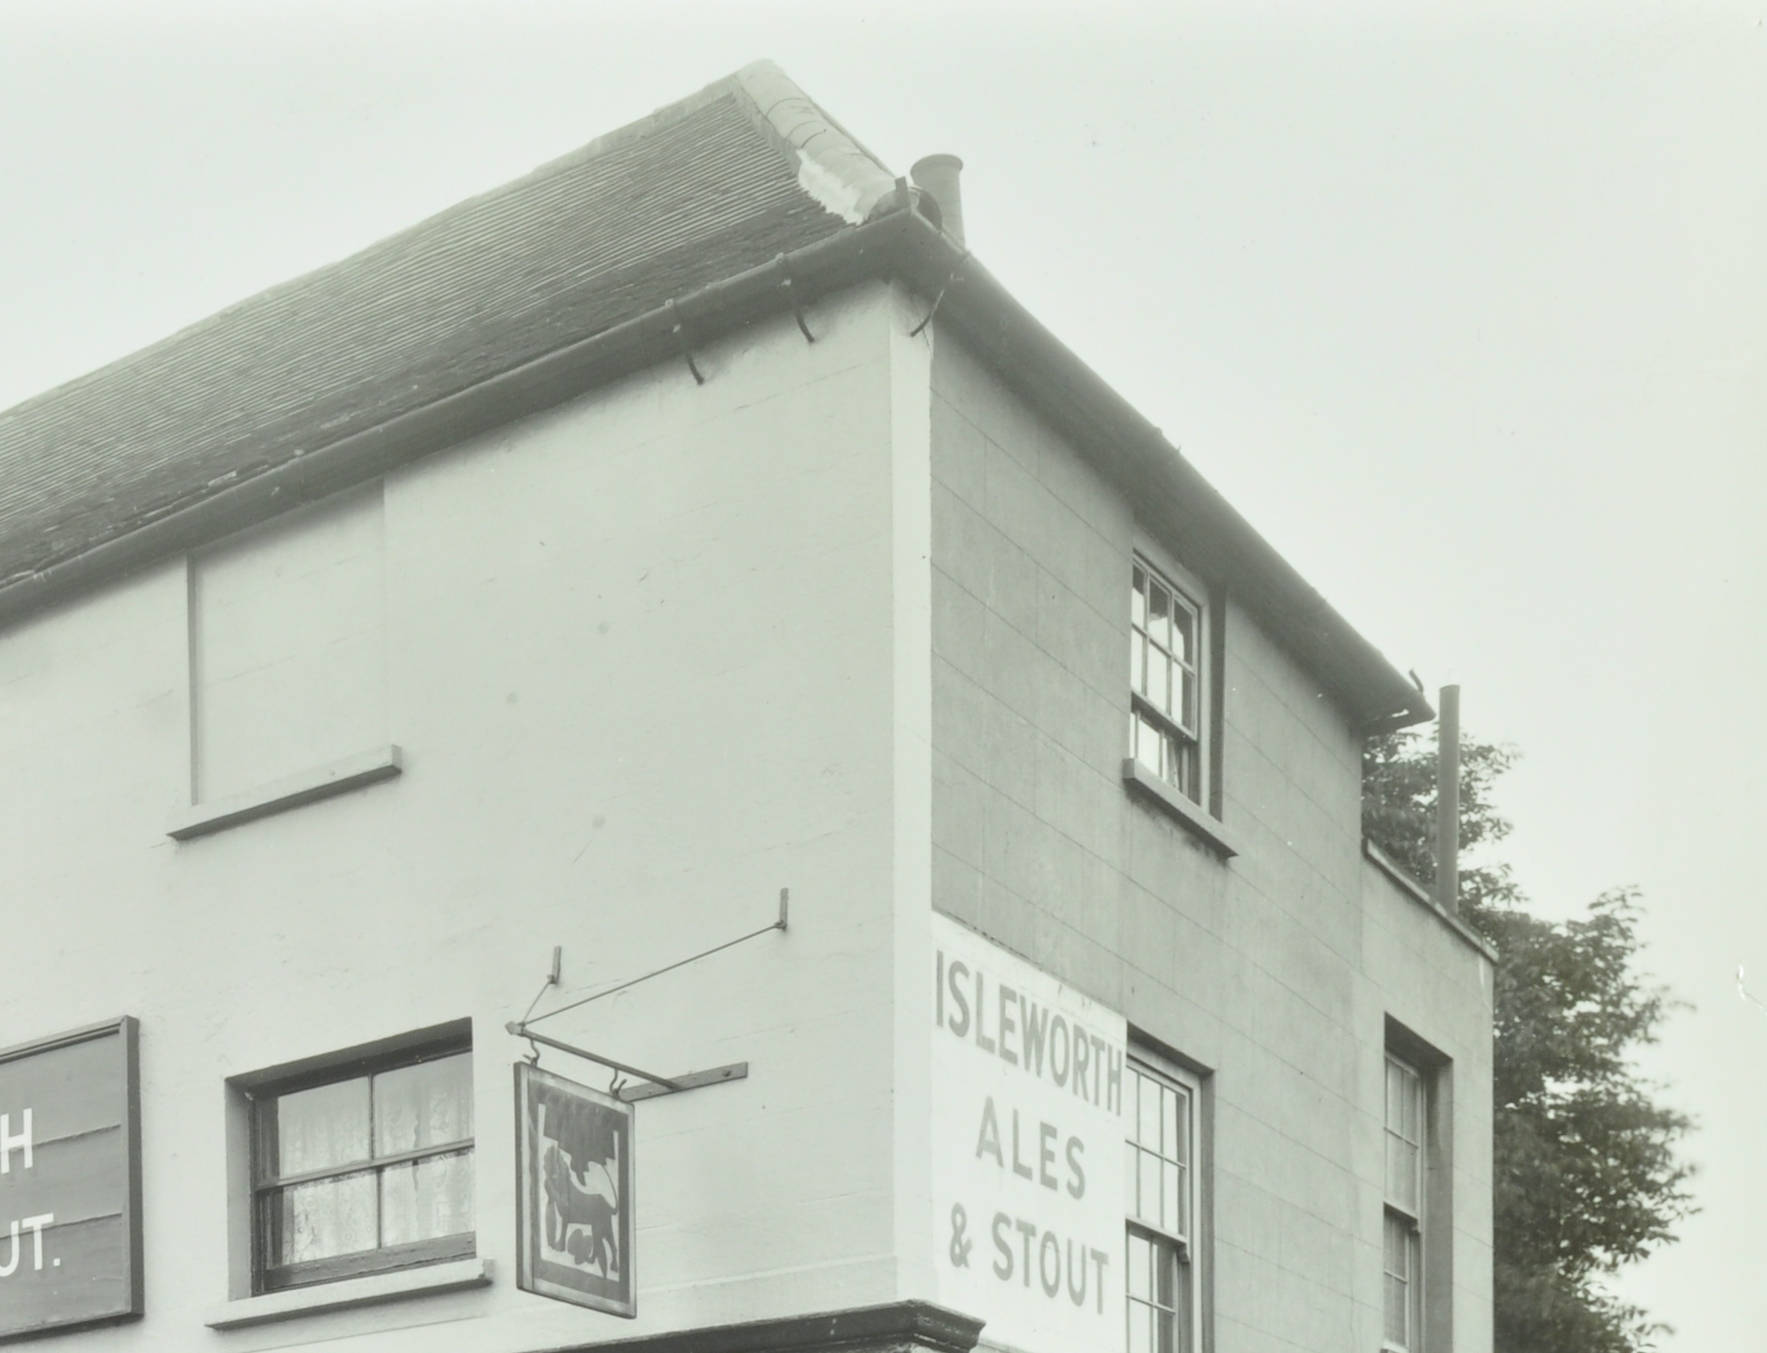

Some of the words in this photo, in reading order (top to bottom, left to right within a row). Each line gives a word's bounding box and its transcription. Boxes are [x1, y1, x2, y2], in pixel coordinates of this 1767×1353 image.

[935, 949, 1123, 1117] ISLEWORTH
[975, 1095, 1087, 1201] ALES
[949, 1202, 972, 1269] &
[991, 1210, 1110, 1316] STOUT
